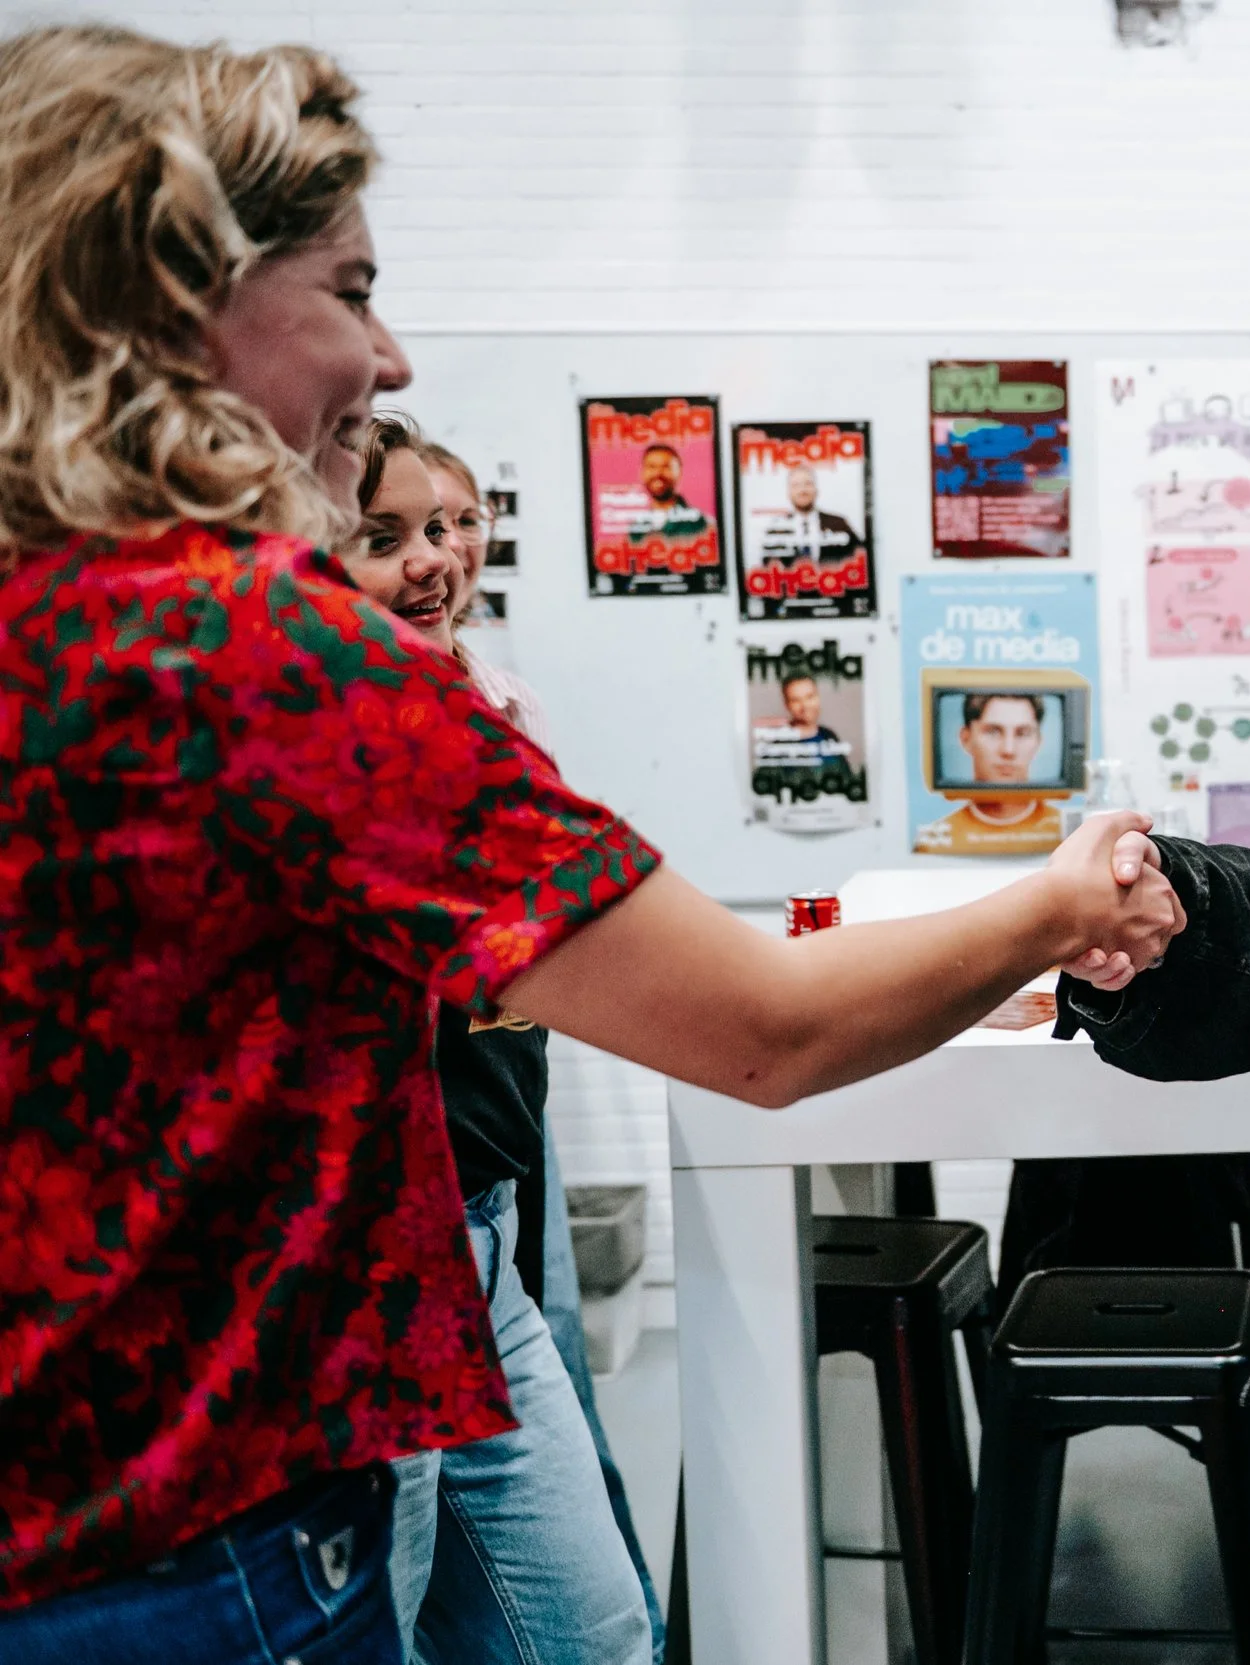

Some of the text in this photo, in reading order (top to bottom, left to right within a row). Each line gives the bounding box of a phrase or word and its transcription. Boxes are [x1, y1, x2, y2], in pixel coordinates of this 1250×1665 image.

[588, 399, 714, 443] media
[739, 426, 865, 472] media
[595, 527, 720, 574] ahead
[746, 549, 869, 598] ahead
[945, 603, 1024, 631] max
[747, 640, 862, 682] media
[919, 628, 1081, 663] de media
[752, 766, 868, 804] ahead
